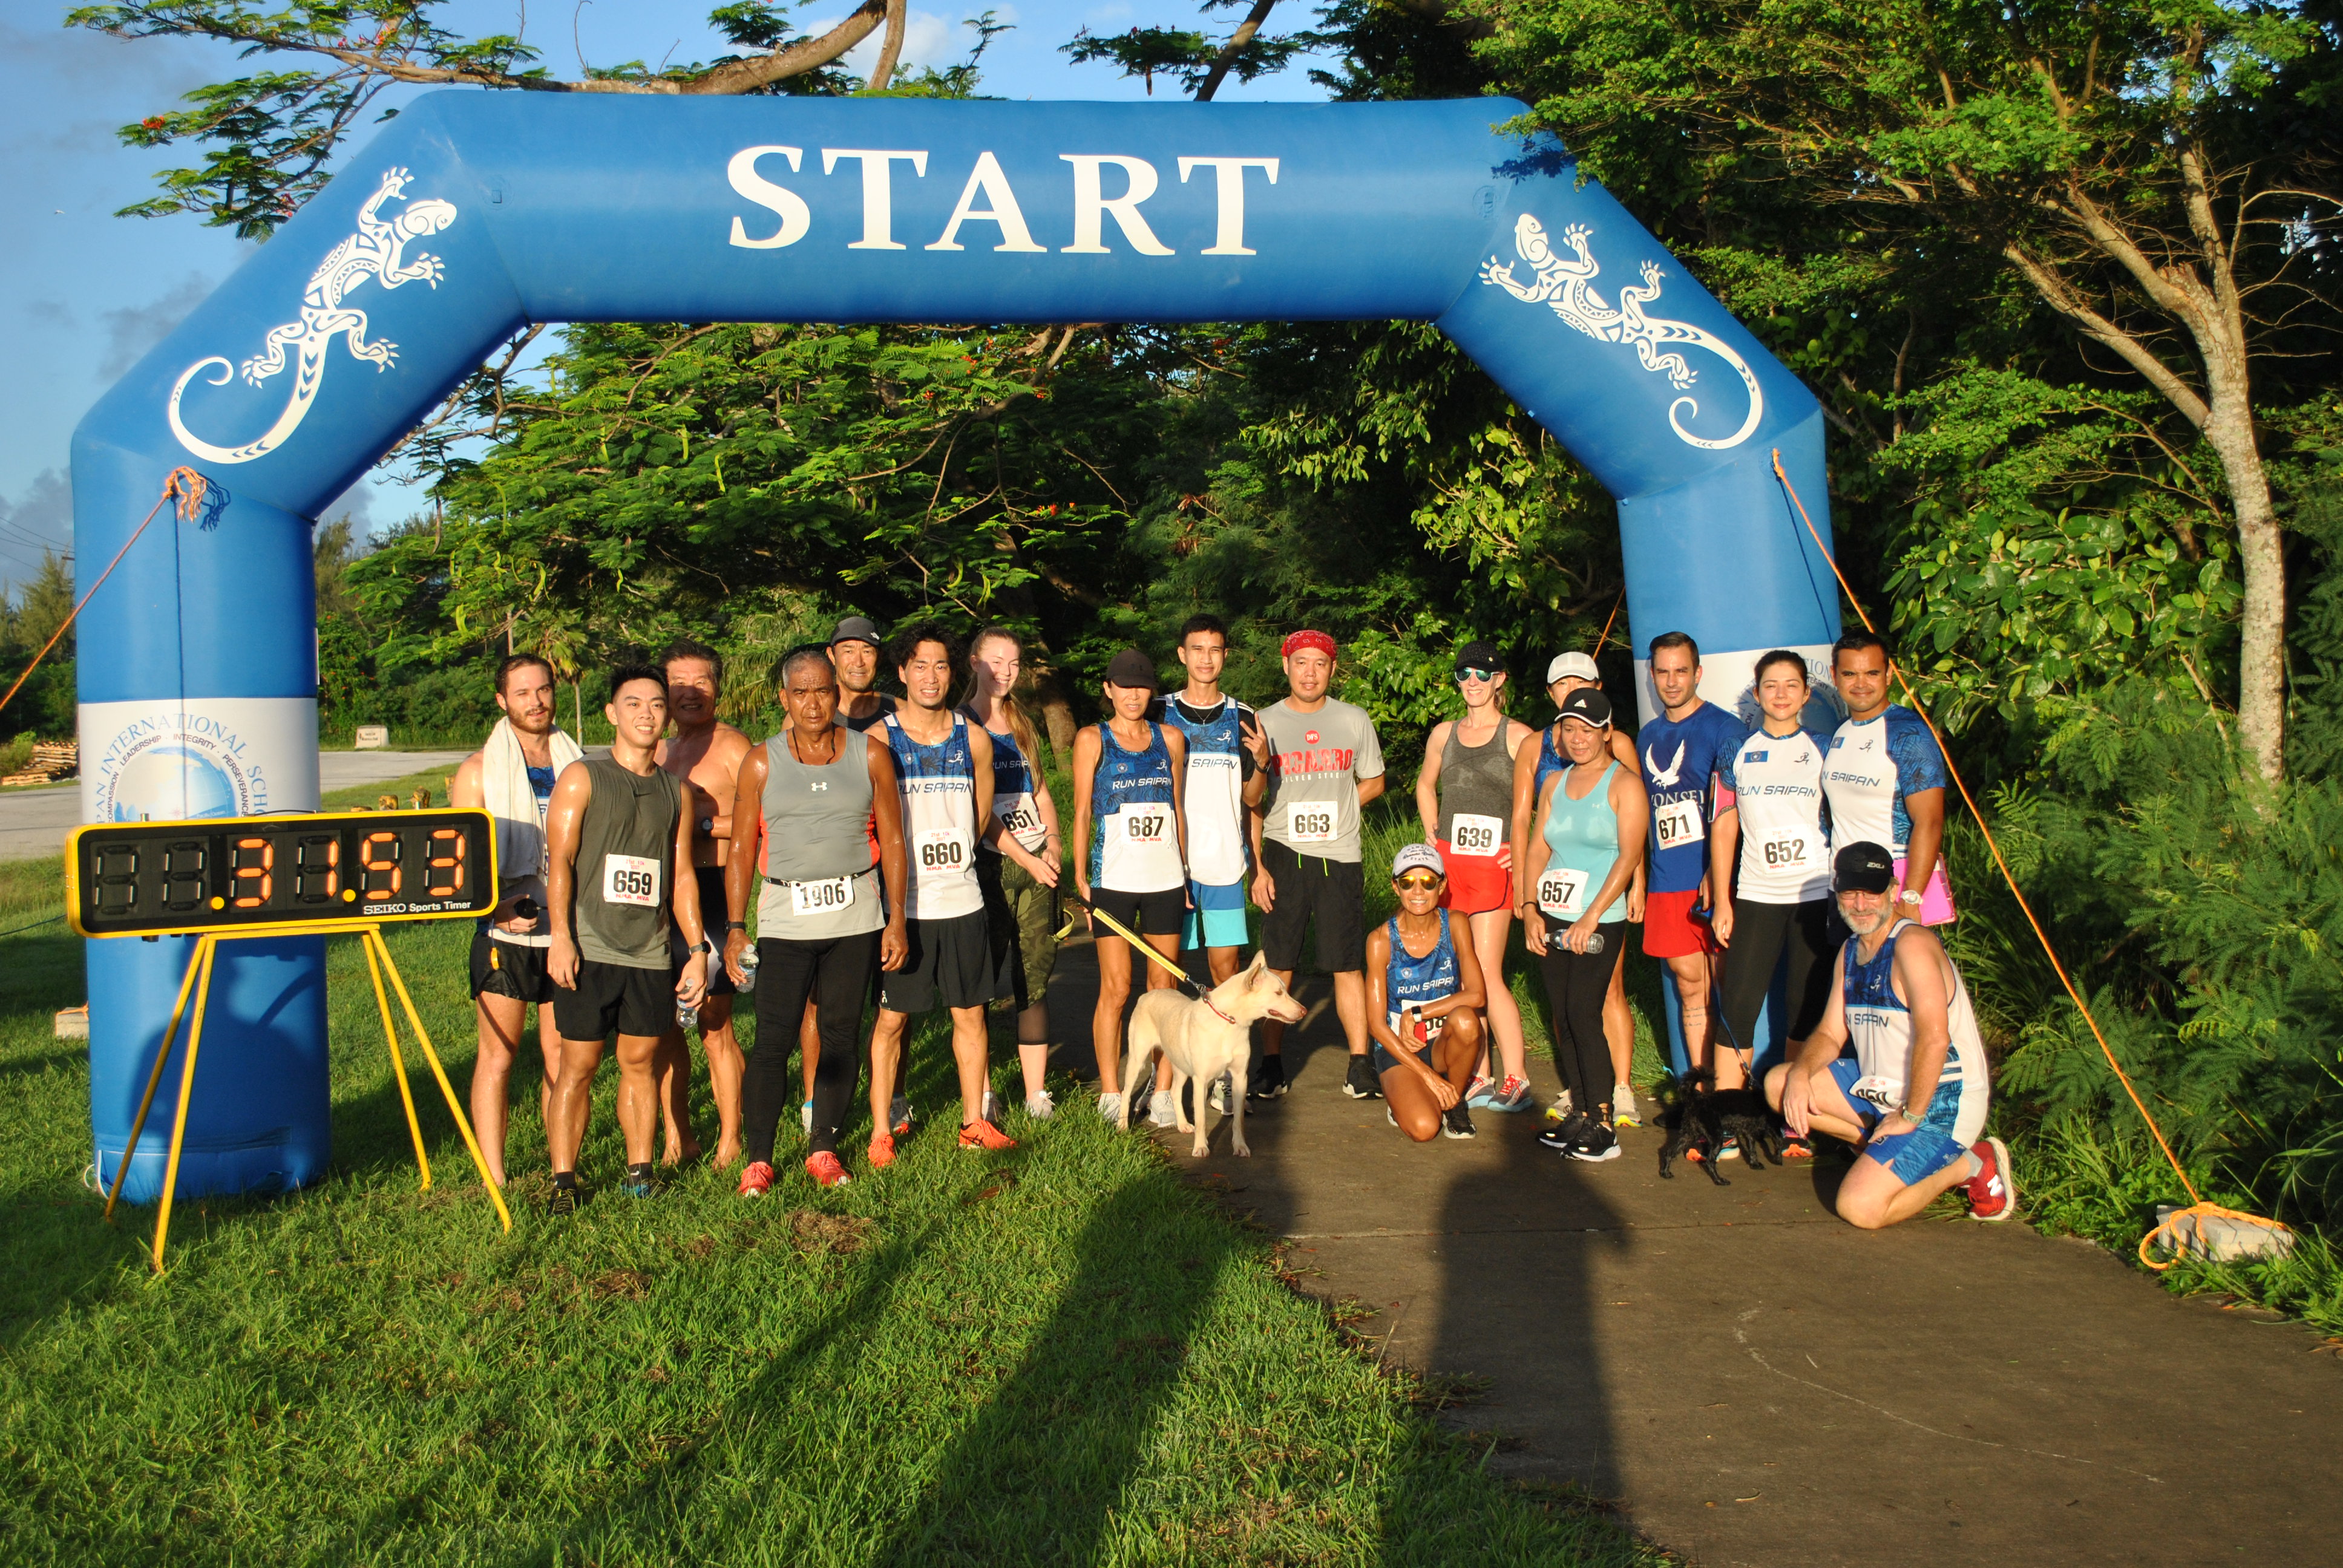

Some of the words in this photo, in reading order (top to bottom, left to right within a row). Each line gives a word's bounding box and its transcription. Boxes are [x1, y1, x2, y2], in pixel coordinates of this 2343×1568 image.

[727, 145, 1280, 256] START
[1807, 676, 1829, 691] TEGRITY
[100, 713, 247, 776] INTERNATIONAL
[120, 734, 162, 766] LEADERSHIP
[173, 733, 217, 751] INTEGRITY
[222, 754, 249, 815] PERSEVERANCE
[1191, 758, 1238, 769] SAIPAN
[924, 782, 972, 793] SAIPAN
[1112, 779, 1136, 790] RUN
[1138, 777, 1172, 786] SAIPAN
[1830, 771, 1881, 787] SAIPAN
[1737, 785, 1761, 796] RUN
[1763, 785, 1817, 797] SAIPAN
[96, 782, 106, 823] PAN
[1001, 809, 1035, 831] 651
[1128, 816, 1164, 837] 687
[1295, 814, 1330, 834] 663
[1658, 814, 1691, 840] 671
[1457, 826, 1493, 848] 639
[922, 841, 962, 866] 660
[1764, 838, 1806, 864] 652
[613, 870, 653, 896] 659
[1541, 880, 1576, 904] 657
[800, 883, 846, 909] 1906
[364, 903, 407, 915] SEIKO
[409, 903, 441, 913] Sports
[444, 901, 471, 909] Timer
[1397, 984, 1421, 995] RUN
